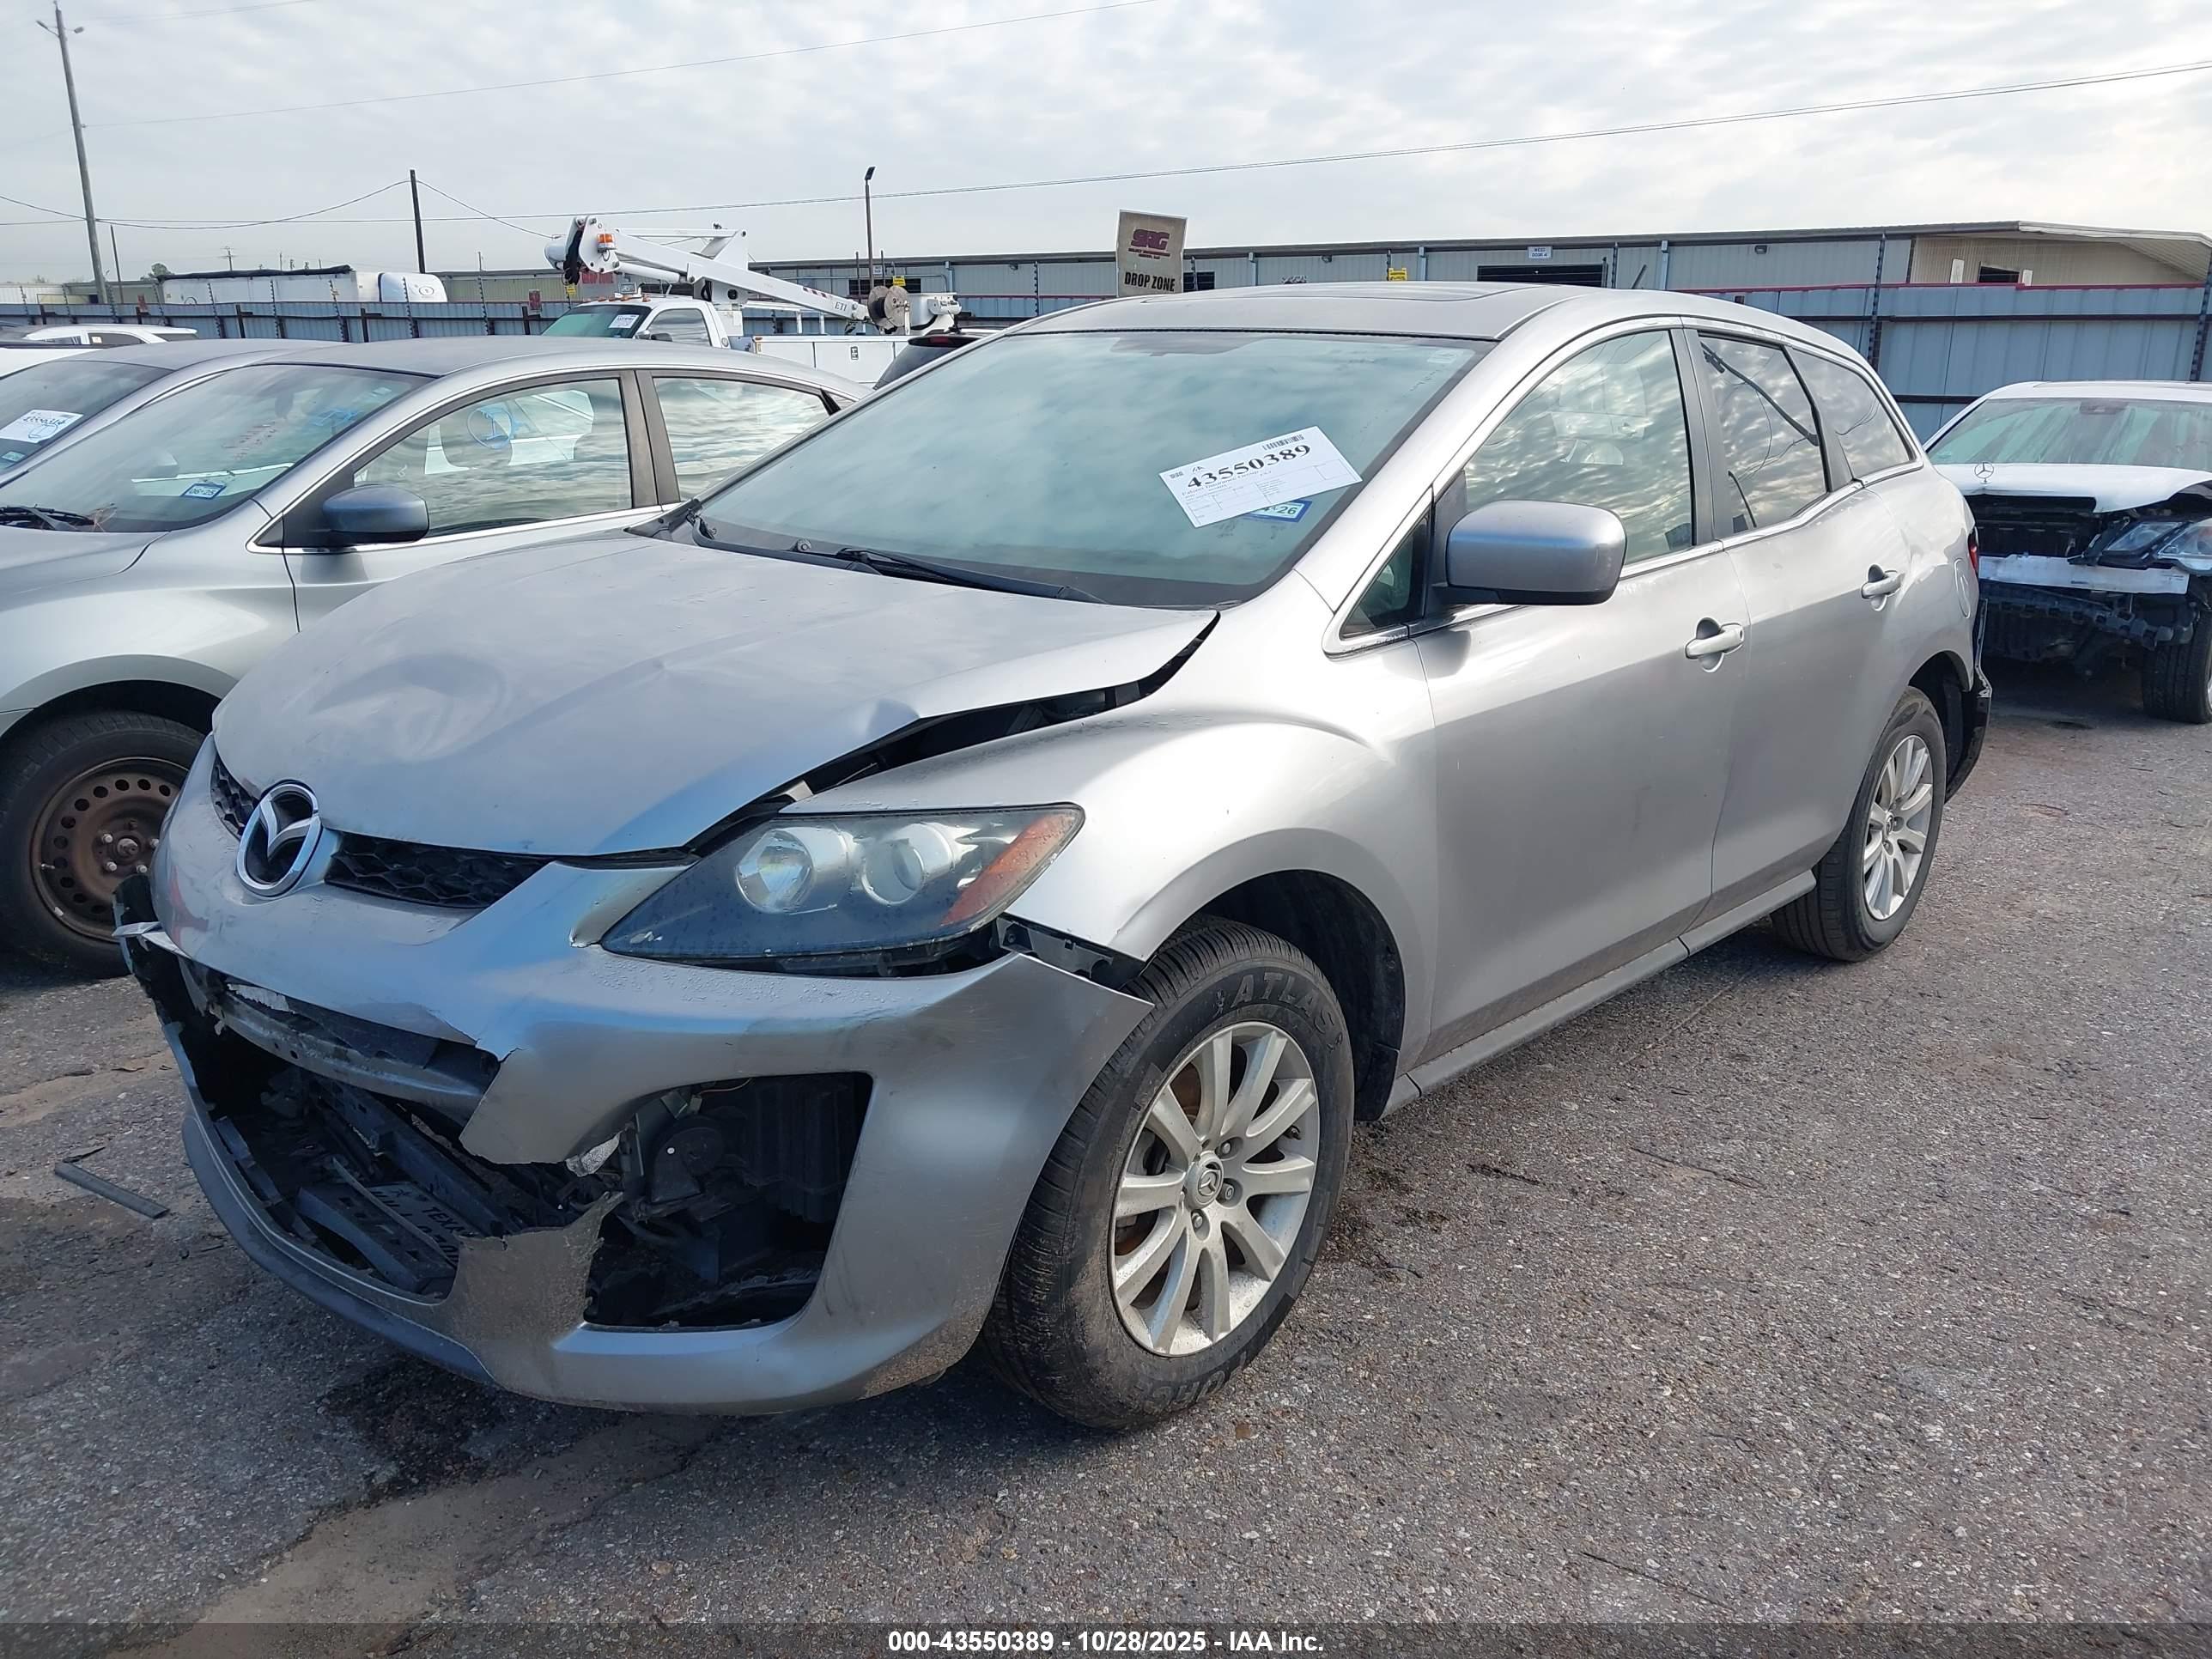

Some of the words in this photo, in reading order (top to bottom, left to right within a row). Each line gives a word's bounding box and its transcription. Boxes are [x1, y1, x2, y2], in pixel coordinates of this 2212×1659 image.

[1124, 271, 1151, 288] DROP
[1151, 276, 1176, 292] ZONE
[1188, 444, 1311, 489] 43550389
[1276, 506, 1297, 515] 26
[1230, 972, 1335, 1035] ATLAS
[421, 1206, 467, 1234] TEXA
